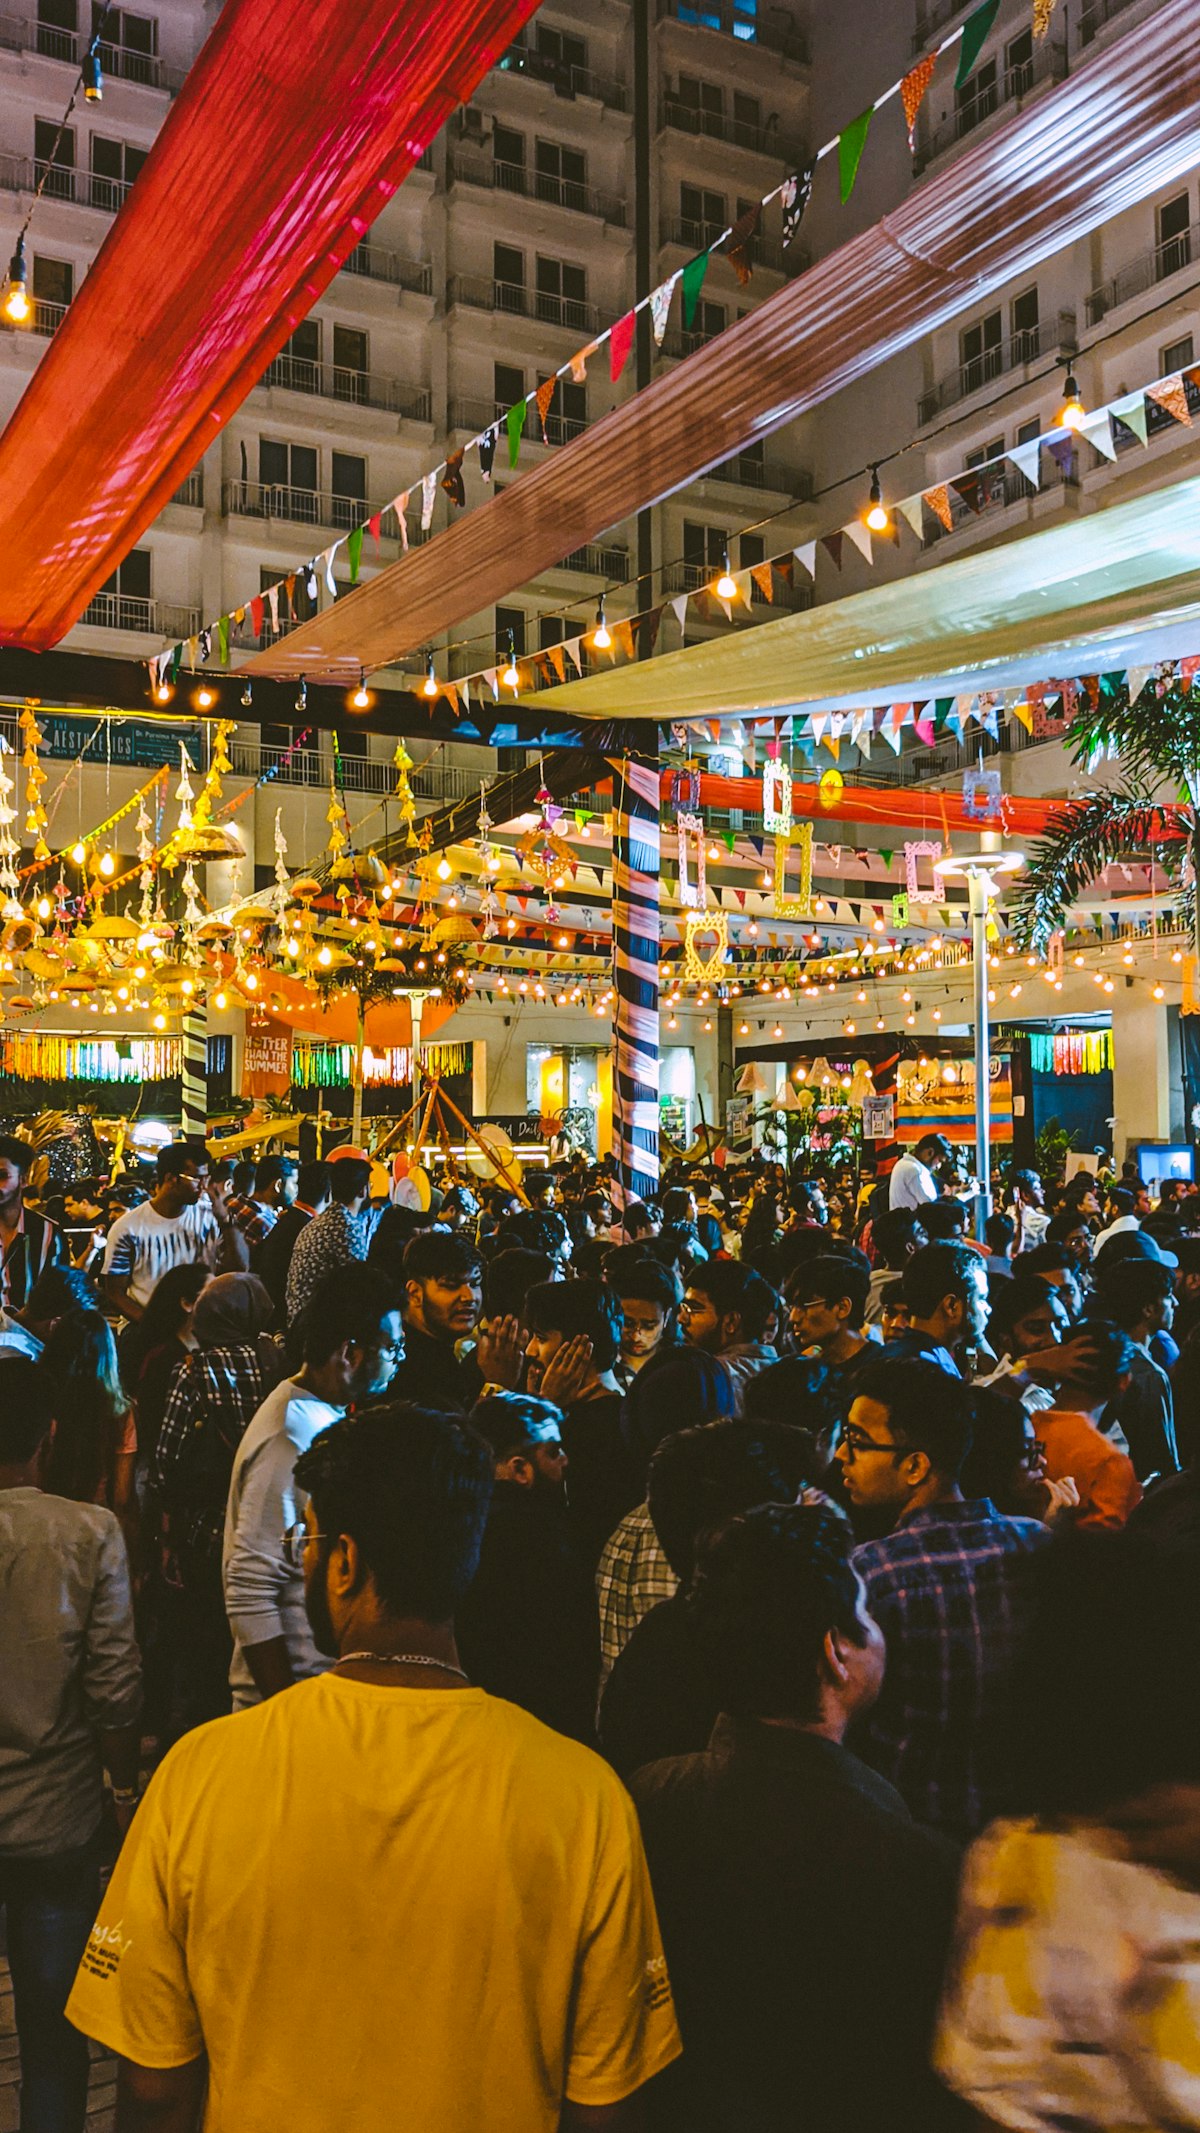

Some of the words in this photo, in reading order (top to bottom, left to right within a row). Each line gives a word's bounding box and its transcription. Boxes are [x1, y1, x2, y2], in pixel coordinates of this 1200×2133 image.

[245, 1048, 269, 1061] THAN
[271, 1050, 288, 1062] THE
[245, 1059, 288, 1075] SUMMER
[519, 1121, 542, 1140] Daily
